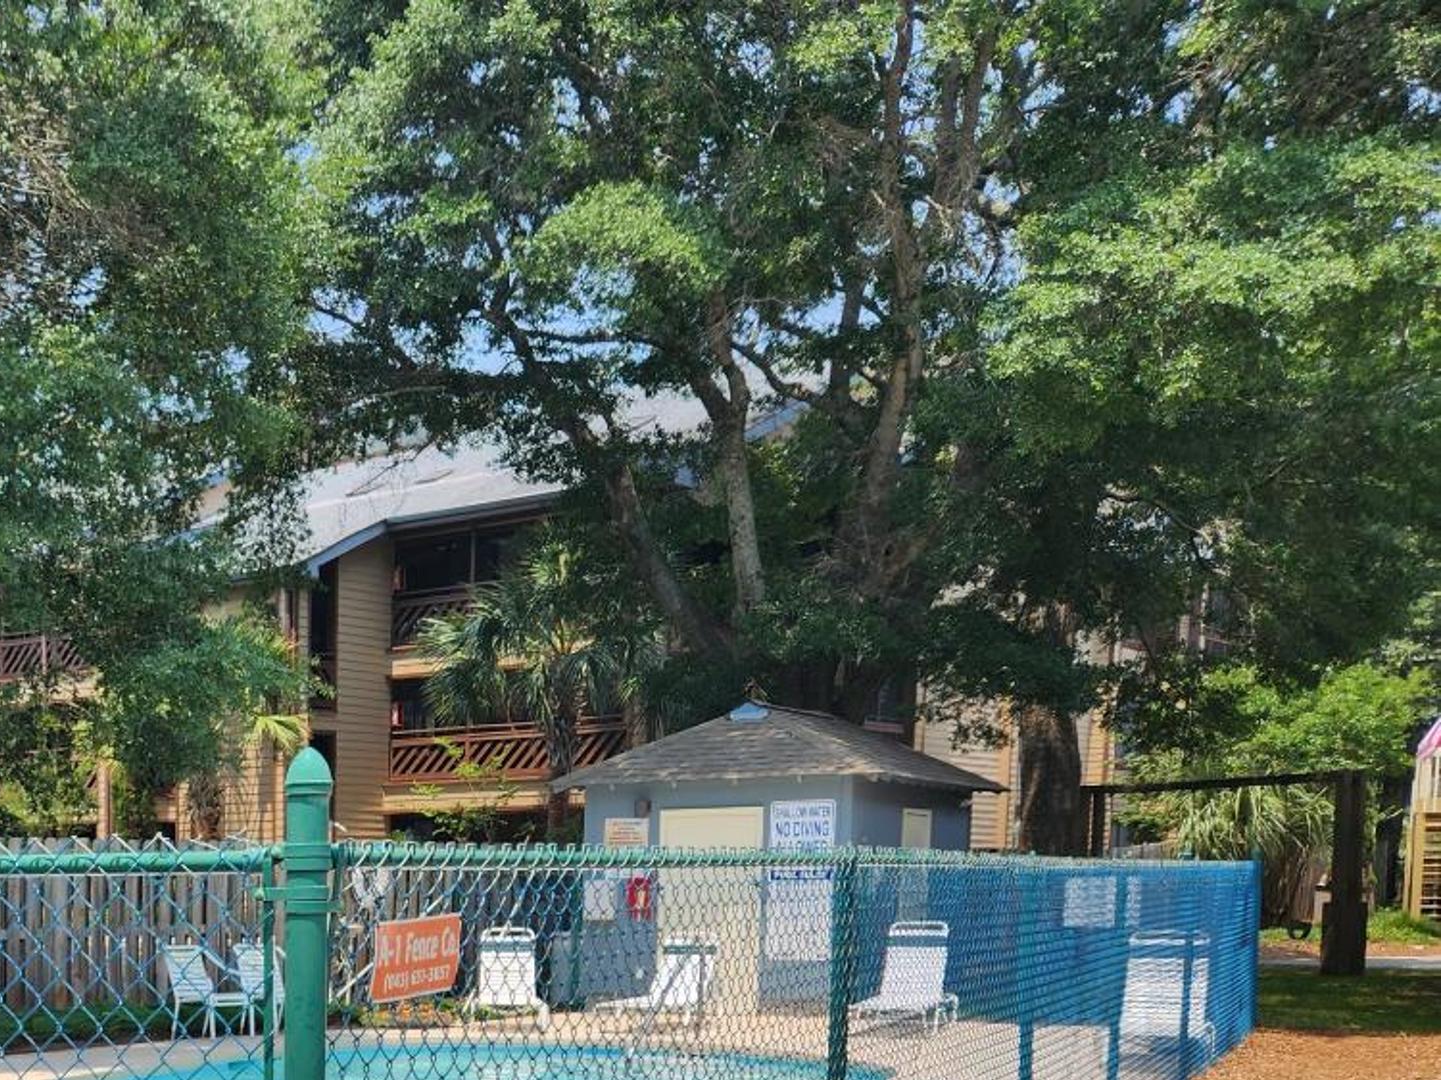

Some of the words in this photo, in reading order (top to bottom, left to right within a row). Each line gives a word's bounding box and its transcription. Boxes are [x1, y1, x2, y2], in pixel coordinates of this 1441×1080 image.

[776, 821, 790, 838] NO
[792, 820, 829, 837] DIVING
[376, 933, 402, 968] A-1
[405, 931, 439, 964] Fence
